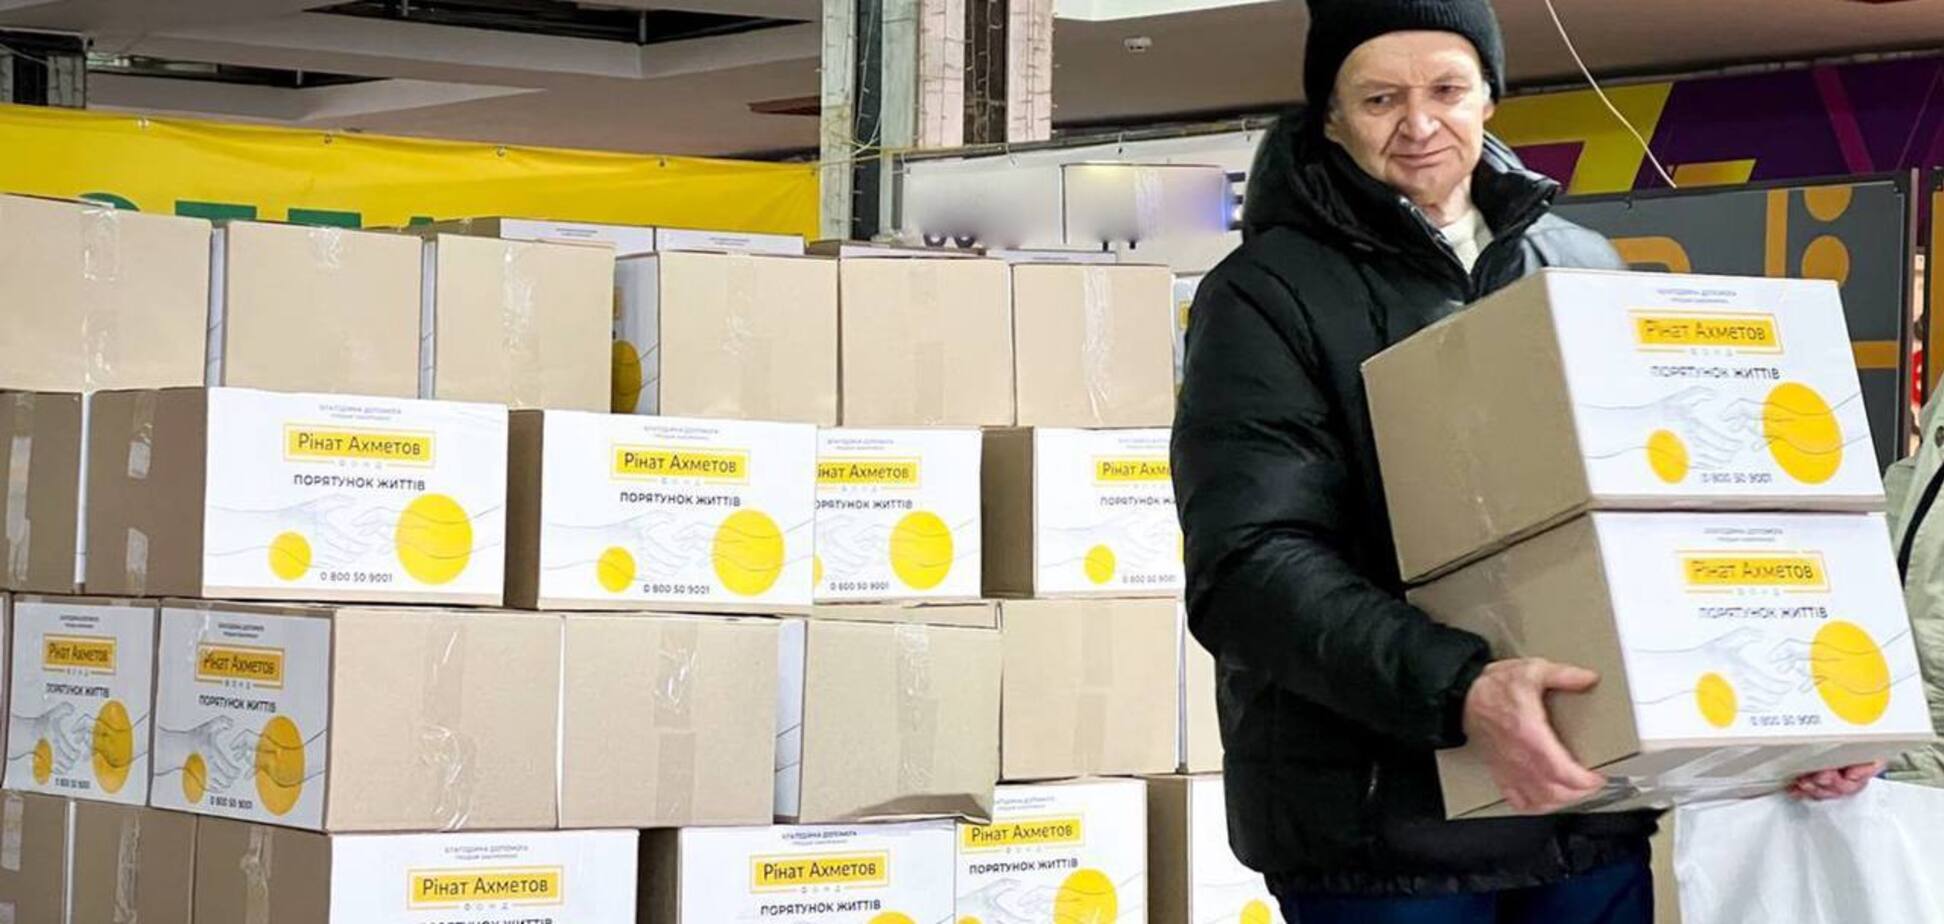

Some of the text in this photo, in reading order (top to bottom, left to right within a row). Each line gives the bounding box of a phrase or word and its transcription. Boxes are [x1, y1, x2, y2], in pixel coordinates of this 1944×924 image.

[1695, 321, 1766, 341] Ахметов
[1733, 367, 1780, 380] ЖИТТІВ
[298, 432, 421, 455] Рінат Ахметов
[624, 452, 737, 473] Рінат Ахметов
[817, 463, 910, 479] інат Ахметов
[1102, 461, 1136, 476] Рінат
[293, 474, 426, 490] ПОРЯТУНОК ЖИТТІВ
[619, 491, 741, 507] ПОРЯТУНОК ЖИТТІВ
[872, 499, 913, 510] ЖИТТІВ
[320, 571, 393, 583] 0 800 50 9001
[1743, 562, 1814, 579] Ахметов
[673, 584, 686, 594] 50
[687, 584, 710, 595] 9001
[1780, 607, 1828, 619] ЖИТТІВ
[231, 655, 275, 674] Ахметов
[971, 824, 1073, 842] Рінат Ахметов
[763, 861, 876, 880] Рінат Ахметов
[968, 858, 1079, 875] ПОРЯТУНОК ЖИТТІВ
[423, 876, 548, 896] Рінат Ахметов
[760, 899, 881, 916] ПОРЯТУНОК ЖИТТІВ
